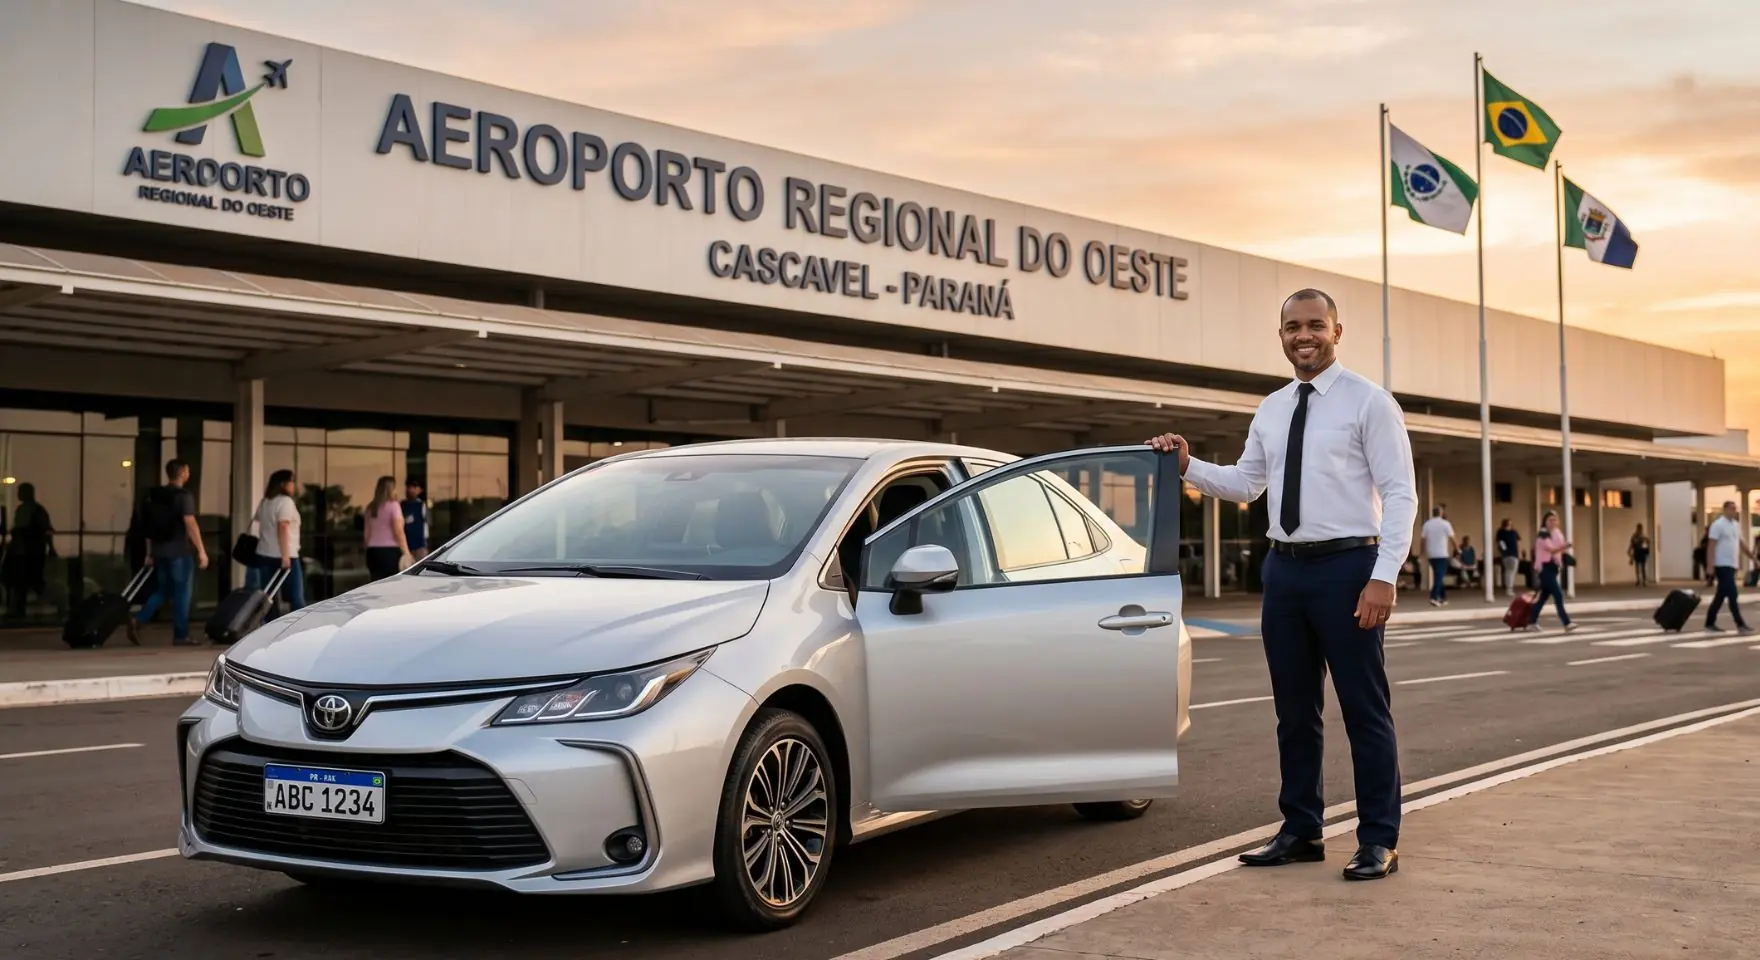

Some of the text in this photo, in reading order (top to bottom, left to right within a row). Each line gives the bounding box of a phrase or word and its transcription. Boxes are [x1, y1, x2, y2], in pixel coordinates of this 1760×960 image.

[138, 185, 294, 221] REGIONAL DO OESTE
[375, 93, 1189, 301] AEROPORTO REGIONAL DO OESTE
[708, 239, 879, 300] CASCAVEL
[903, 271, 1015, 320] PARANÁ
[275, 783, 375, 817] ABC 1234
